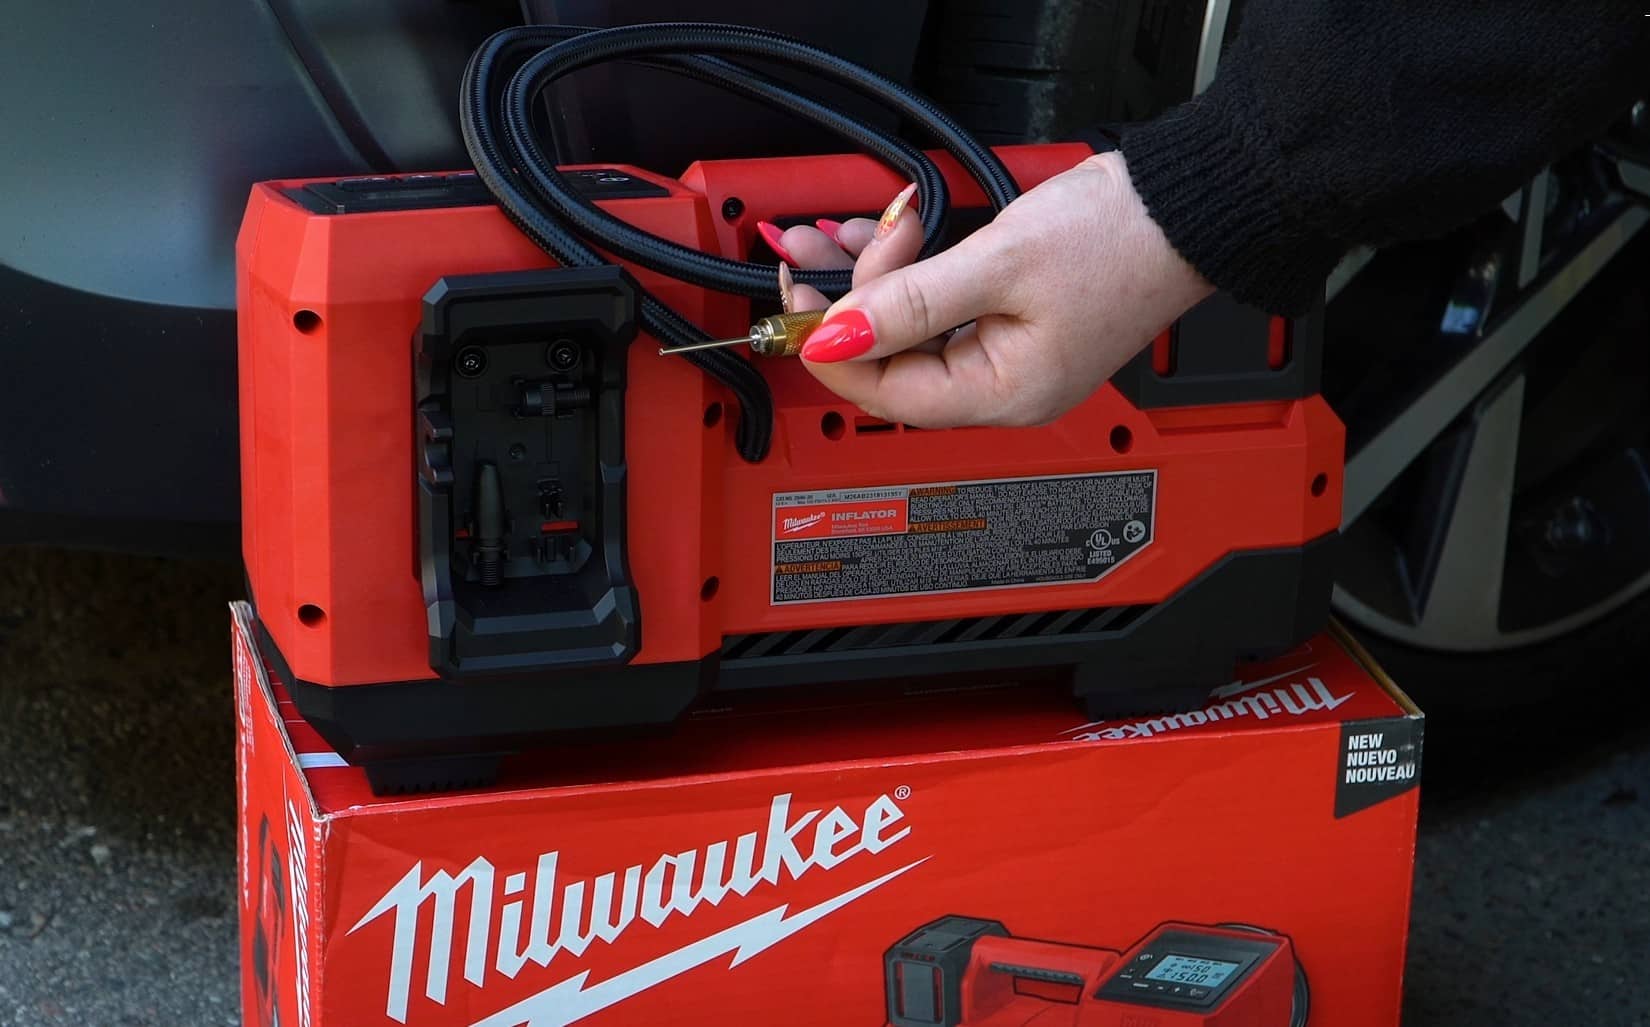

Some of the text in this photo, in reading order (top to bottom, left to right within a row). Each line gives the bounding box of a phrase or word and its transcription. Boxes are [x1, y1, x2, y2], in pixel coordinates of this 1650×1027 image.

[915, 486, 954, 496] WARNING
[832, 510, 896, 520] INFLATOR
[916, 519, 984, 531] AVERTISSEMENT
[785, 561, 839, 572] ADVERTENCIA
[1348, 733, 1384, 750] NEW
[1346, 749, 1398, 767] NUEVO
[1346, 763, 1416, 784] NOUVEAU
